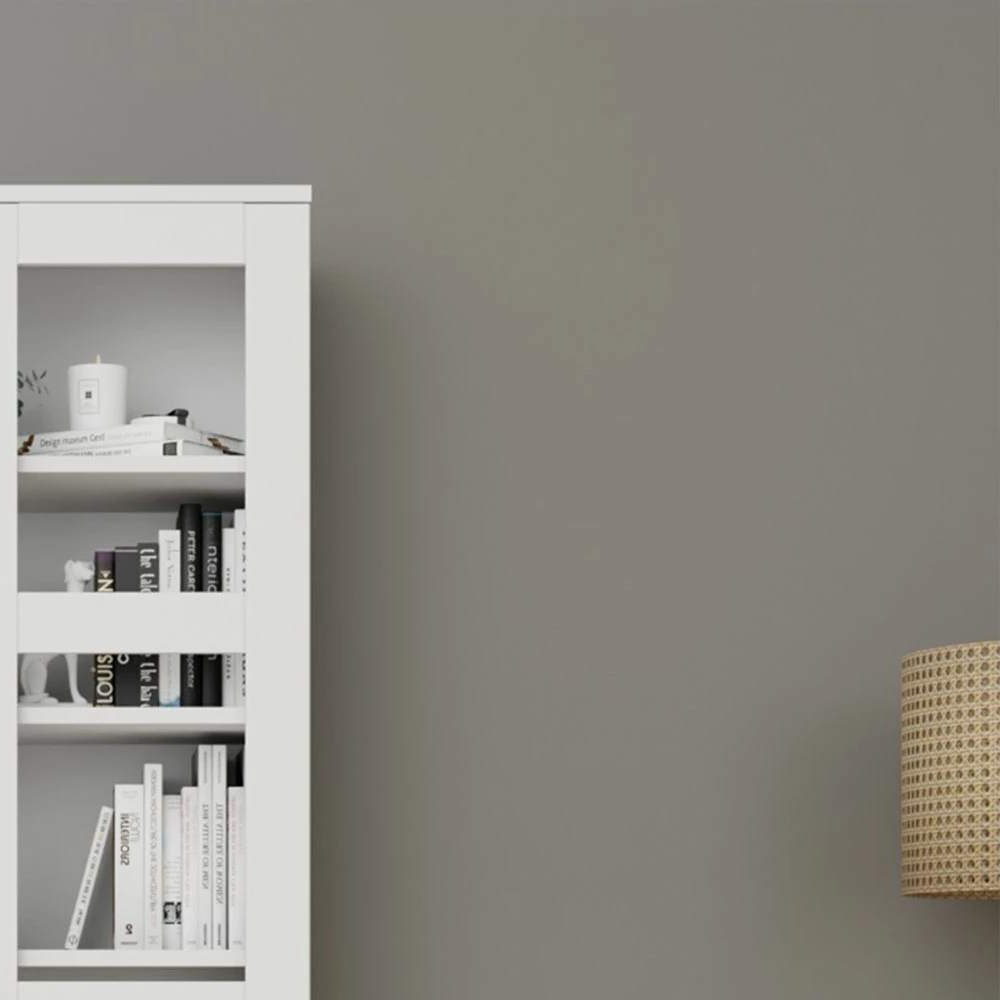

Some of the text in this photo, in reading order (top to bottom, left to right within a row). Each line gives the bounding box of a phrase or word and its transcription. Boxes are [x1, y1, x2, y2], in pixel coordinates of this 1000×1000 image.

[40, 438, 60, 448] Design
[140, 549, 157, 568] the
[187, 530, 196, 592] PETER CARE
[96, 654, 114, 703] LOUIS
[140, 662, 157, 682] the
